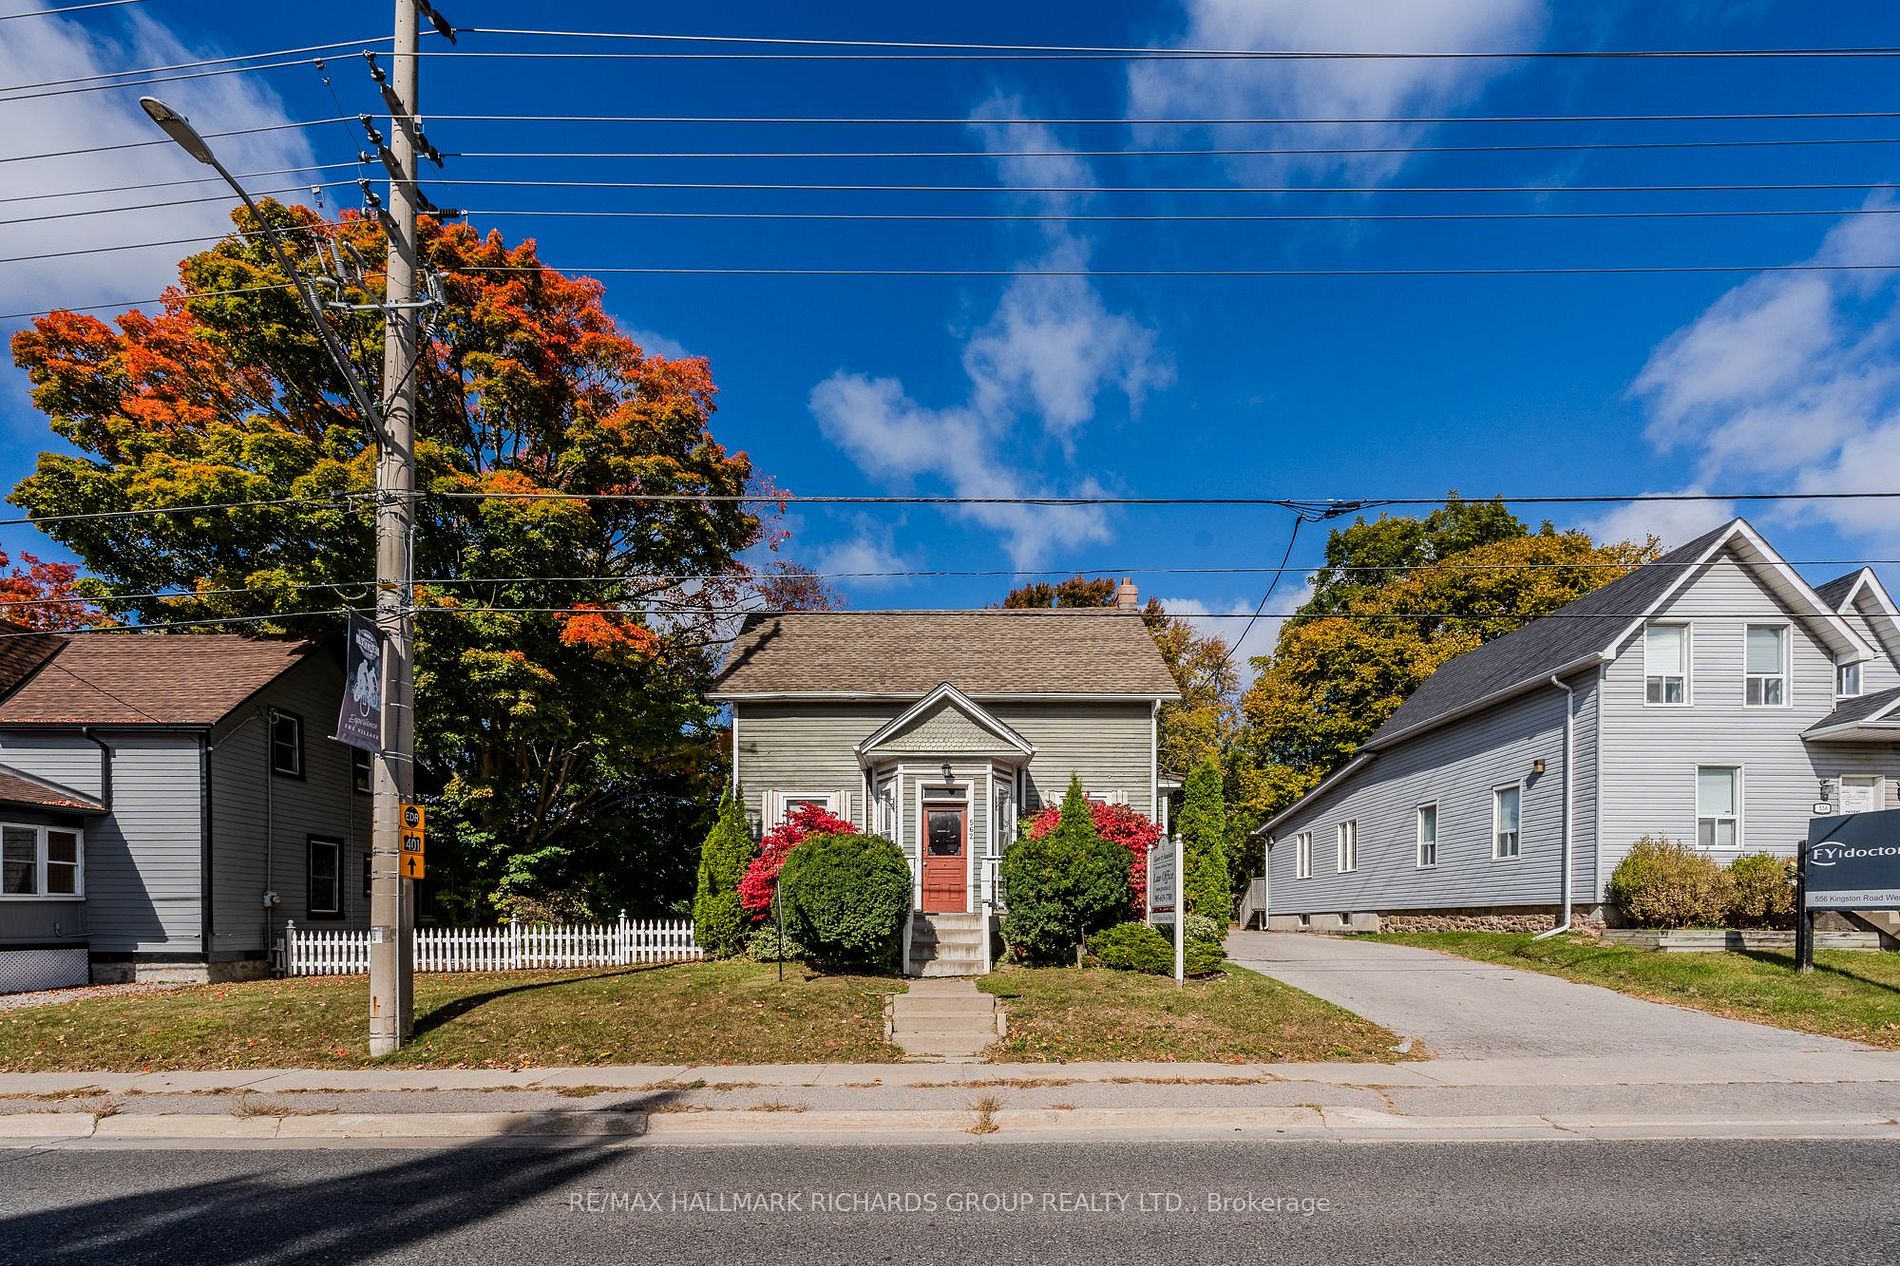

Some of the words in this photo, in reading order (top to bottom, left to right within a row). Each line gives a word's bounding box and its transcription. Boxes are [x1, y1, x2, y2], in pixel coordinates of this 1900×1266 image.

[405, 811, 419, 823] EDR
[405, 838, 420, 851] 401
[1815, 895, 1828, 903] 556
[1829, 894, 1861, 903] Kingston
[1863, 894, 1884, 902] Road
[1885, 893, 1900, 901] We
